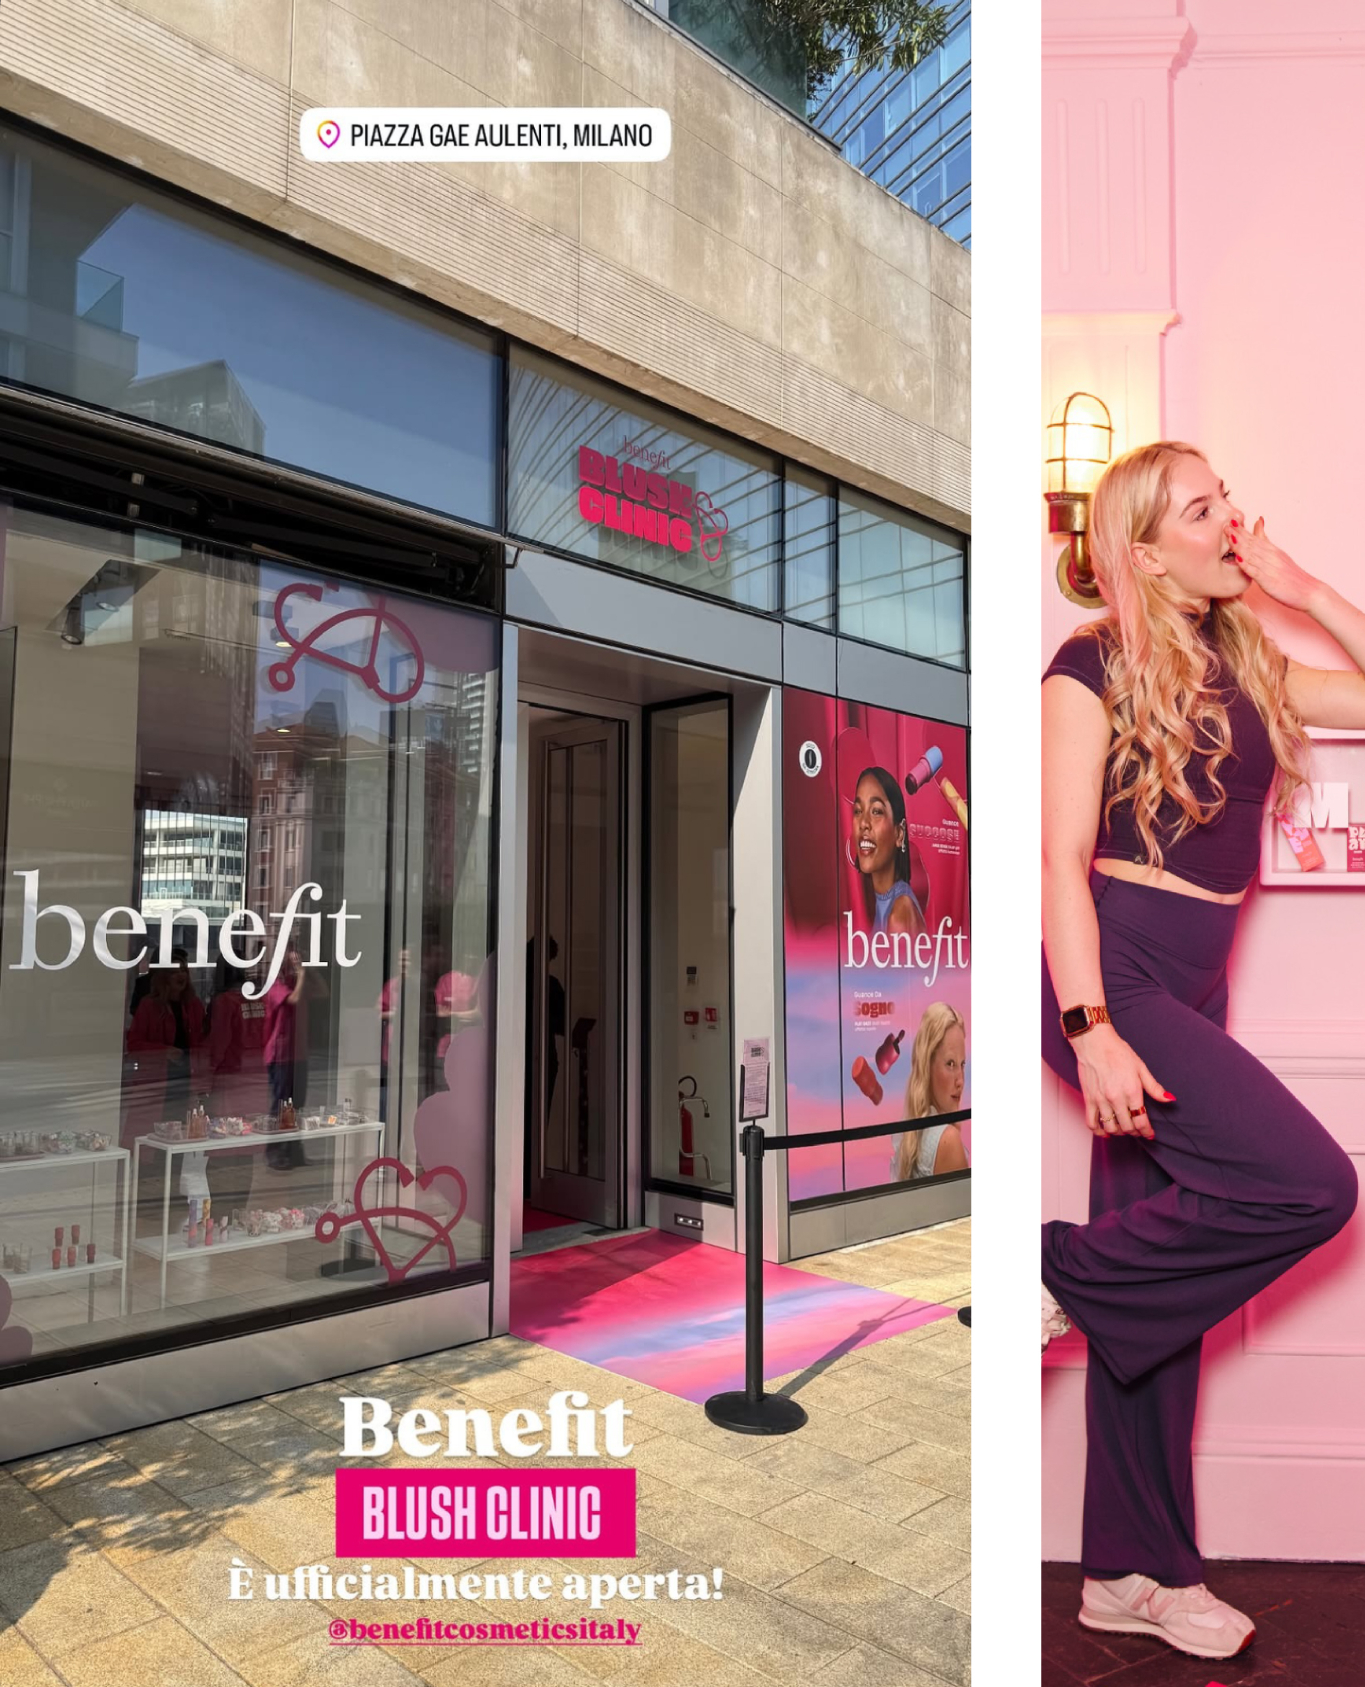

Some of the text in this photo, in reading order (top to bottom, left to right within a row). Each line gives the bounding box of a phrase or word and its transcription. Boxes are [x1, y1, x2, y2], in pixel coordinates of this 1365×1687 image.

[578, 444, 693, 520] BLUSH
[623, 435, 672, 471] benefit
[578, 485, 693, 553] CLINIC
[1296, 782, 1349, 829] M
[8, 869, 363, 1000] benefit
[843, 910, 969, 988] benefit
